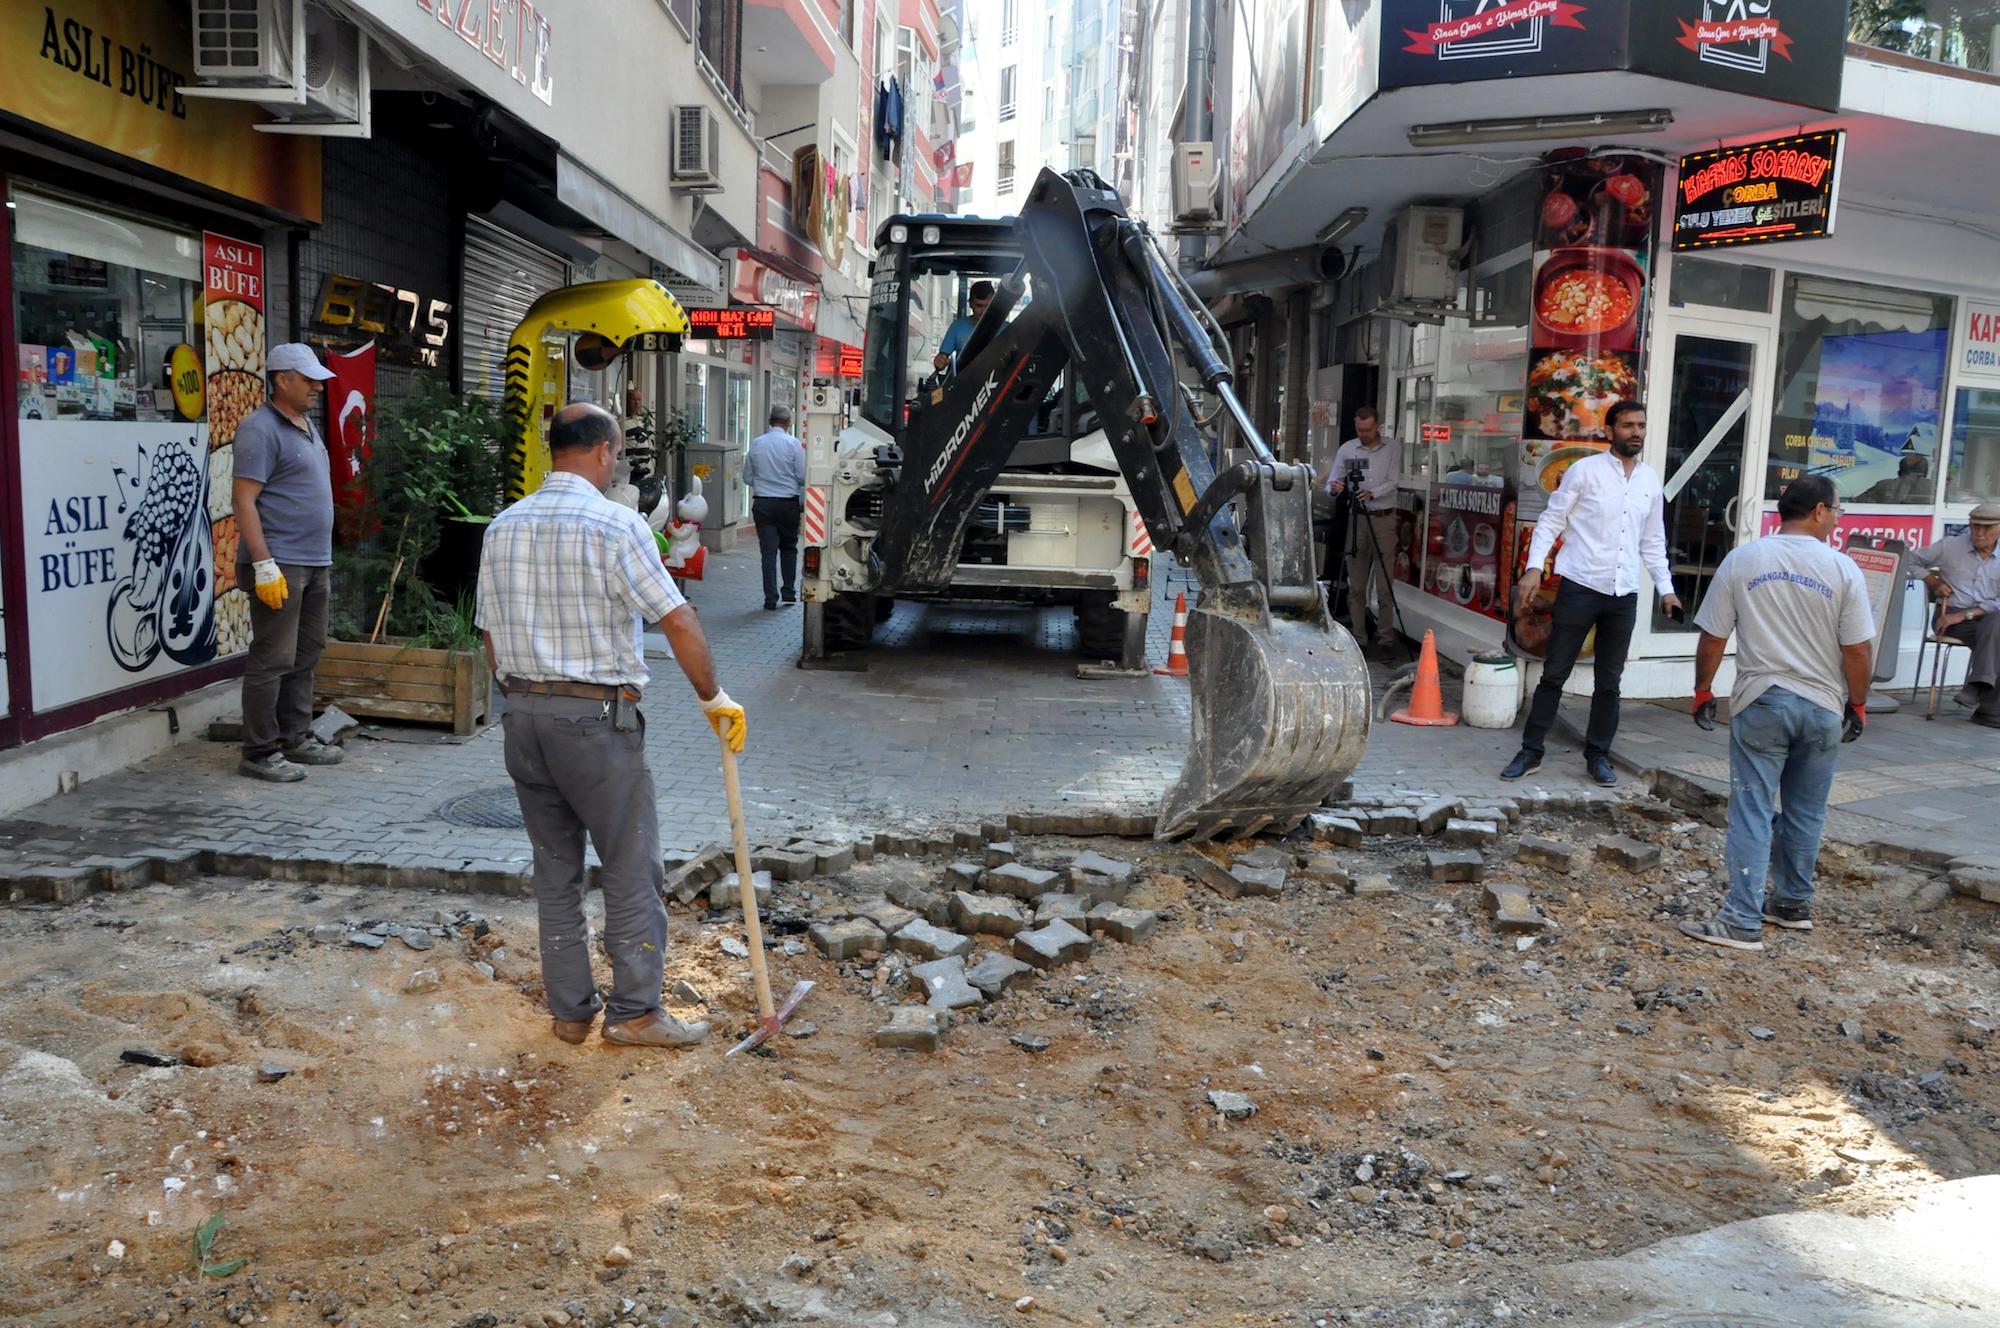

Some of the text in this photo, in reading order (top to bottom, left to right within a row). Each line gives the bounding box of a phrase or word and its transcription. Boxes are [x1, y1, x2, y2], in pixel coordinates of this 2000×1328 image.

[1432, 27, 1460, 41] Sinan
[1486, 17, 1493, 26] &
[40, 6, 187, 120] ASLI BÜFE
[417, 0, 553, 107] ZETE
[1683, 150, 1829, 205] KAFKAS SOFRASI
[1722, 181, 1778, 208] ÇORBA
[1711, 206, 1755, 227] YEMEK
[1755, 194, 1824, 225] ÇEŞİTLERİ
[214, 244, 254, 267] ASLI
[208, 263, 260, 298] BÜFE
[1967, 349, 1995, 368] ÇORBA
[44, 495, 109, 536] ASLI
[40, 541, 117, 592] BÜFE
